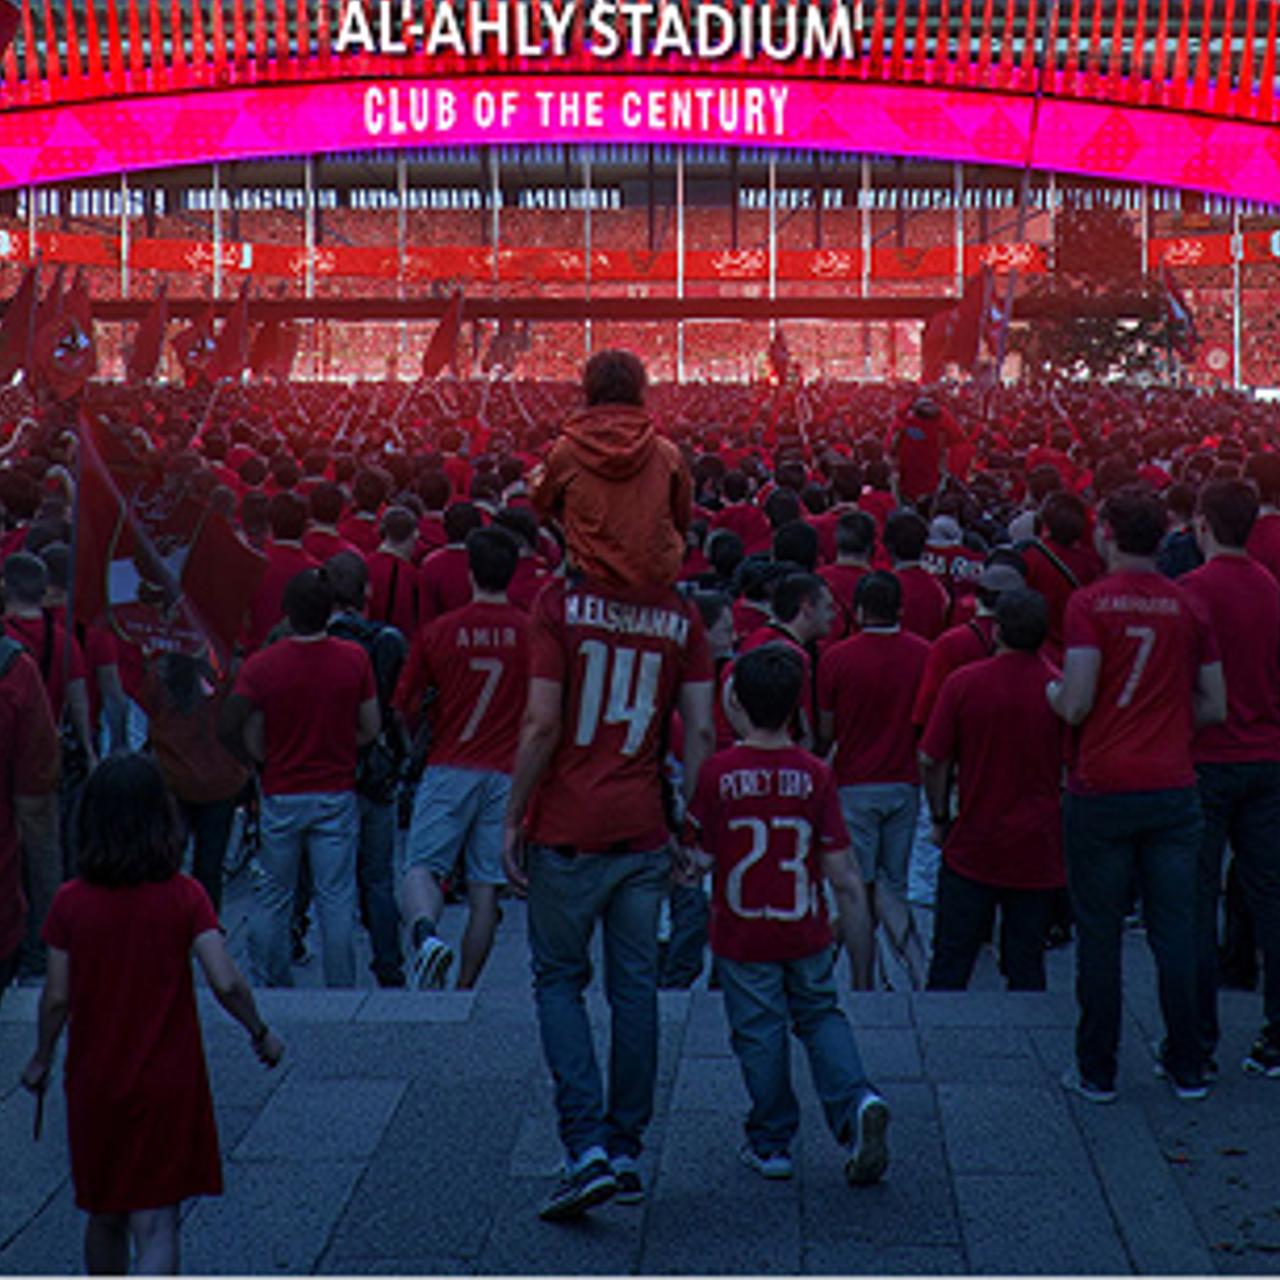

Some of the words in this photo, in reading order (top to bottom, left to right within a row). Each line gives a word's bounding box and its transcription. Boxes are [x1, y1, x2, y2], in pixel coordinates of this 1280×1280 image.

[335, 0, 575, 56] AL-AHLY
[589, 1, 856, 60] STADIUM
[363, 86, 457, 136] CLUB
[473, 90, 519, 129] OF
[536, 90, 605, 128] THE
[621, 85, 789, 136] CENTURY
[456, 627, 517, 648] AMIR
[1116, 626, 1156, 708] 7
[458, 657, 504, 743] 7
[575, 639, 663, 756] 14
[725, 815, 813, 922] 23
